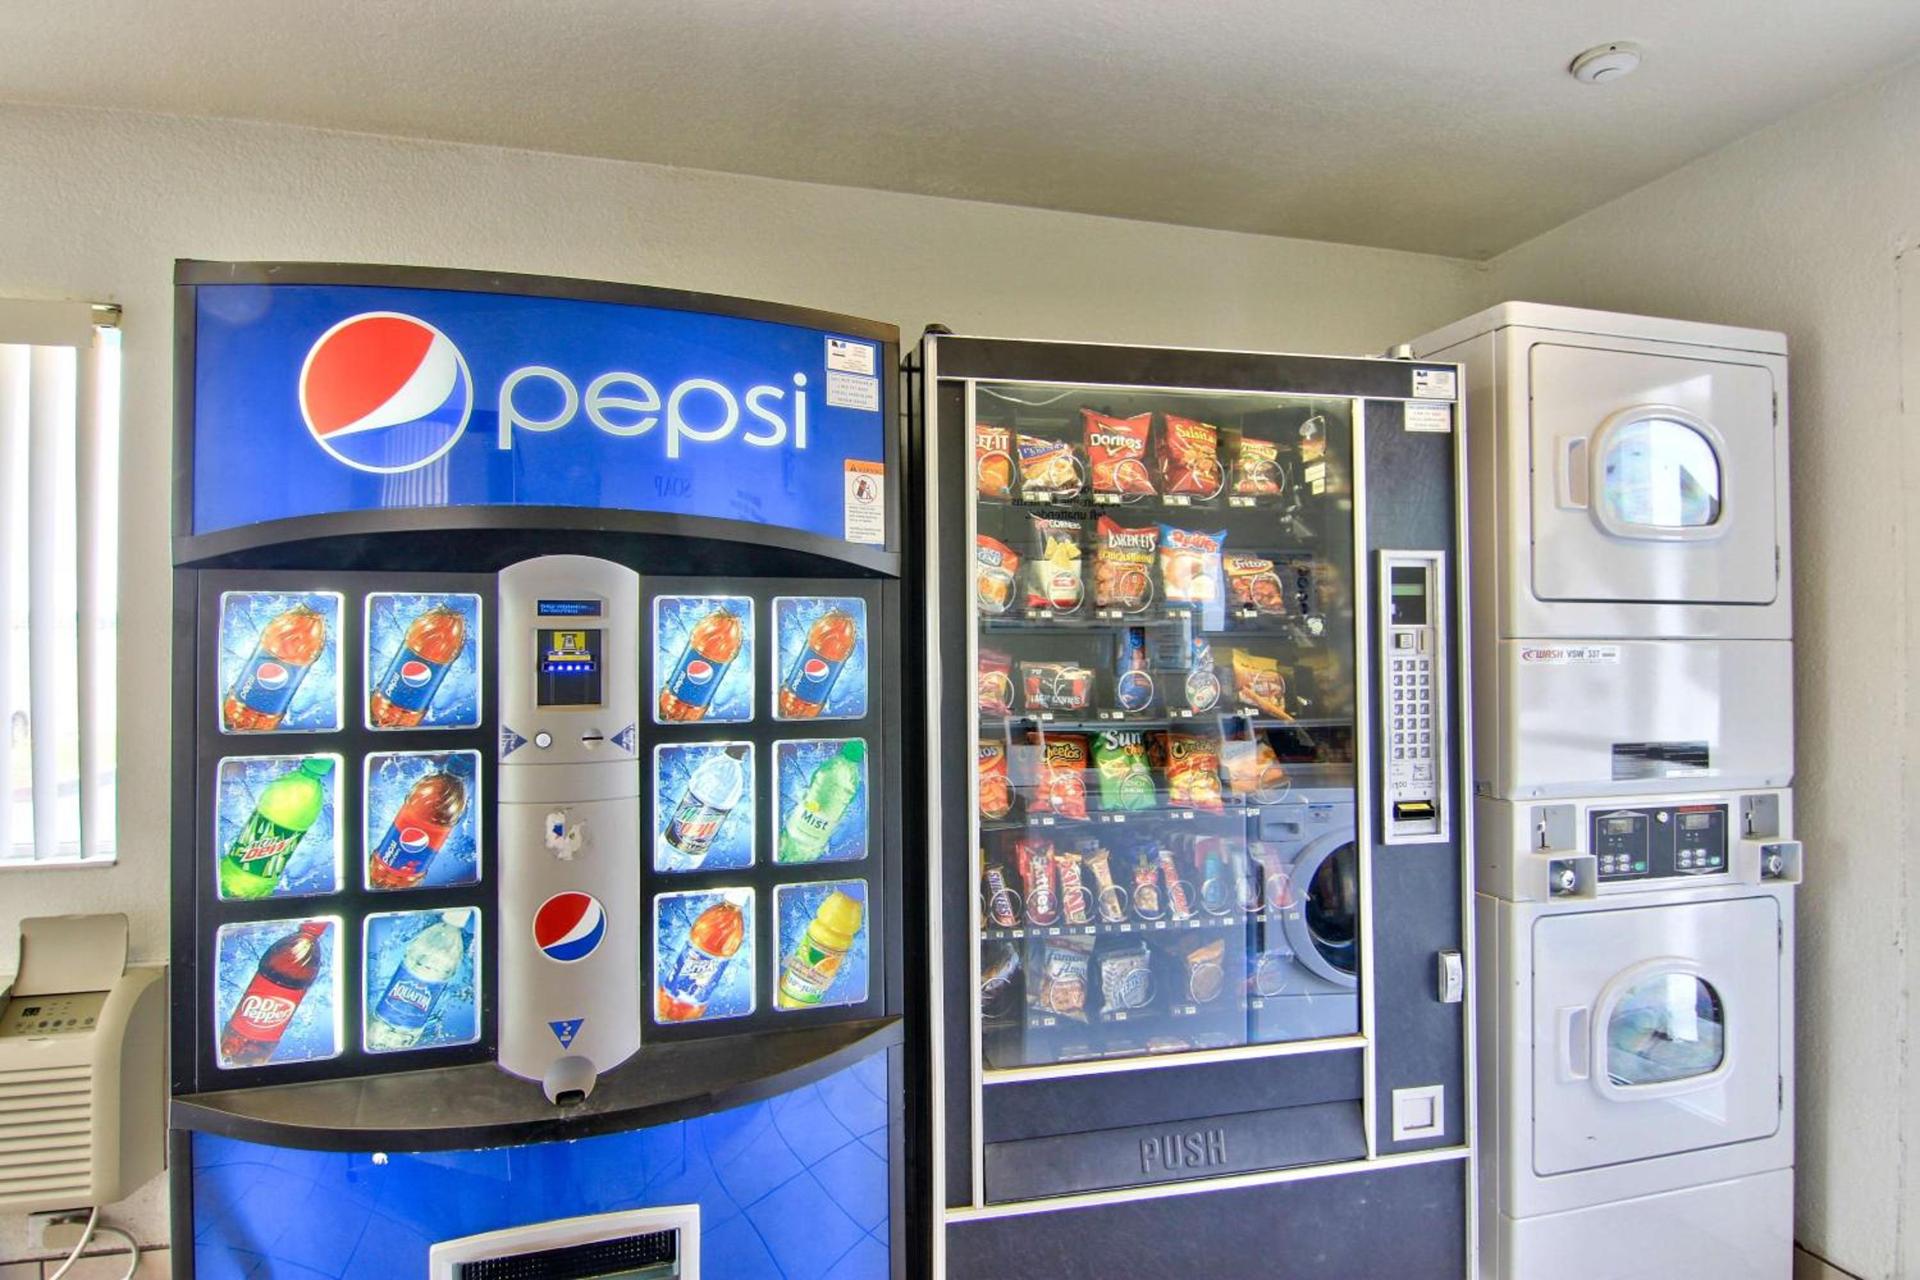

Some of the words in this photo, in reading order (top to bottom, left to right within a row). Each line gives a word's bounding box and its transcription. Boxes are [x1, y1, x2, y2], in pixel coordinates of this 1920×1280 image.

[498, 366, 808, 459] pepsi
[1091, 432, 1143, 449] Doritos
[1104, 729, 1142, 751] Sun
[800, 809, 829, 831] Mist
[1139, 1128, 1227, 1174] PUSH
